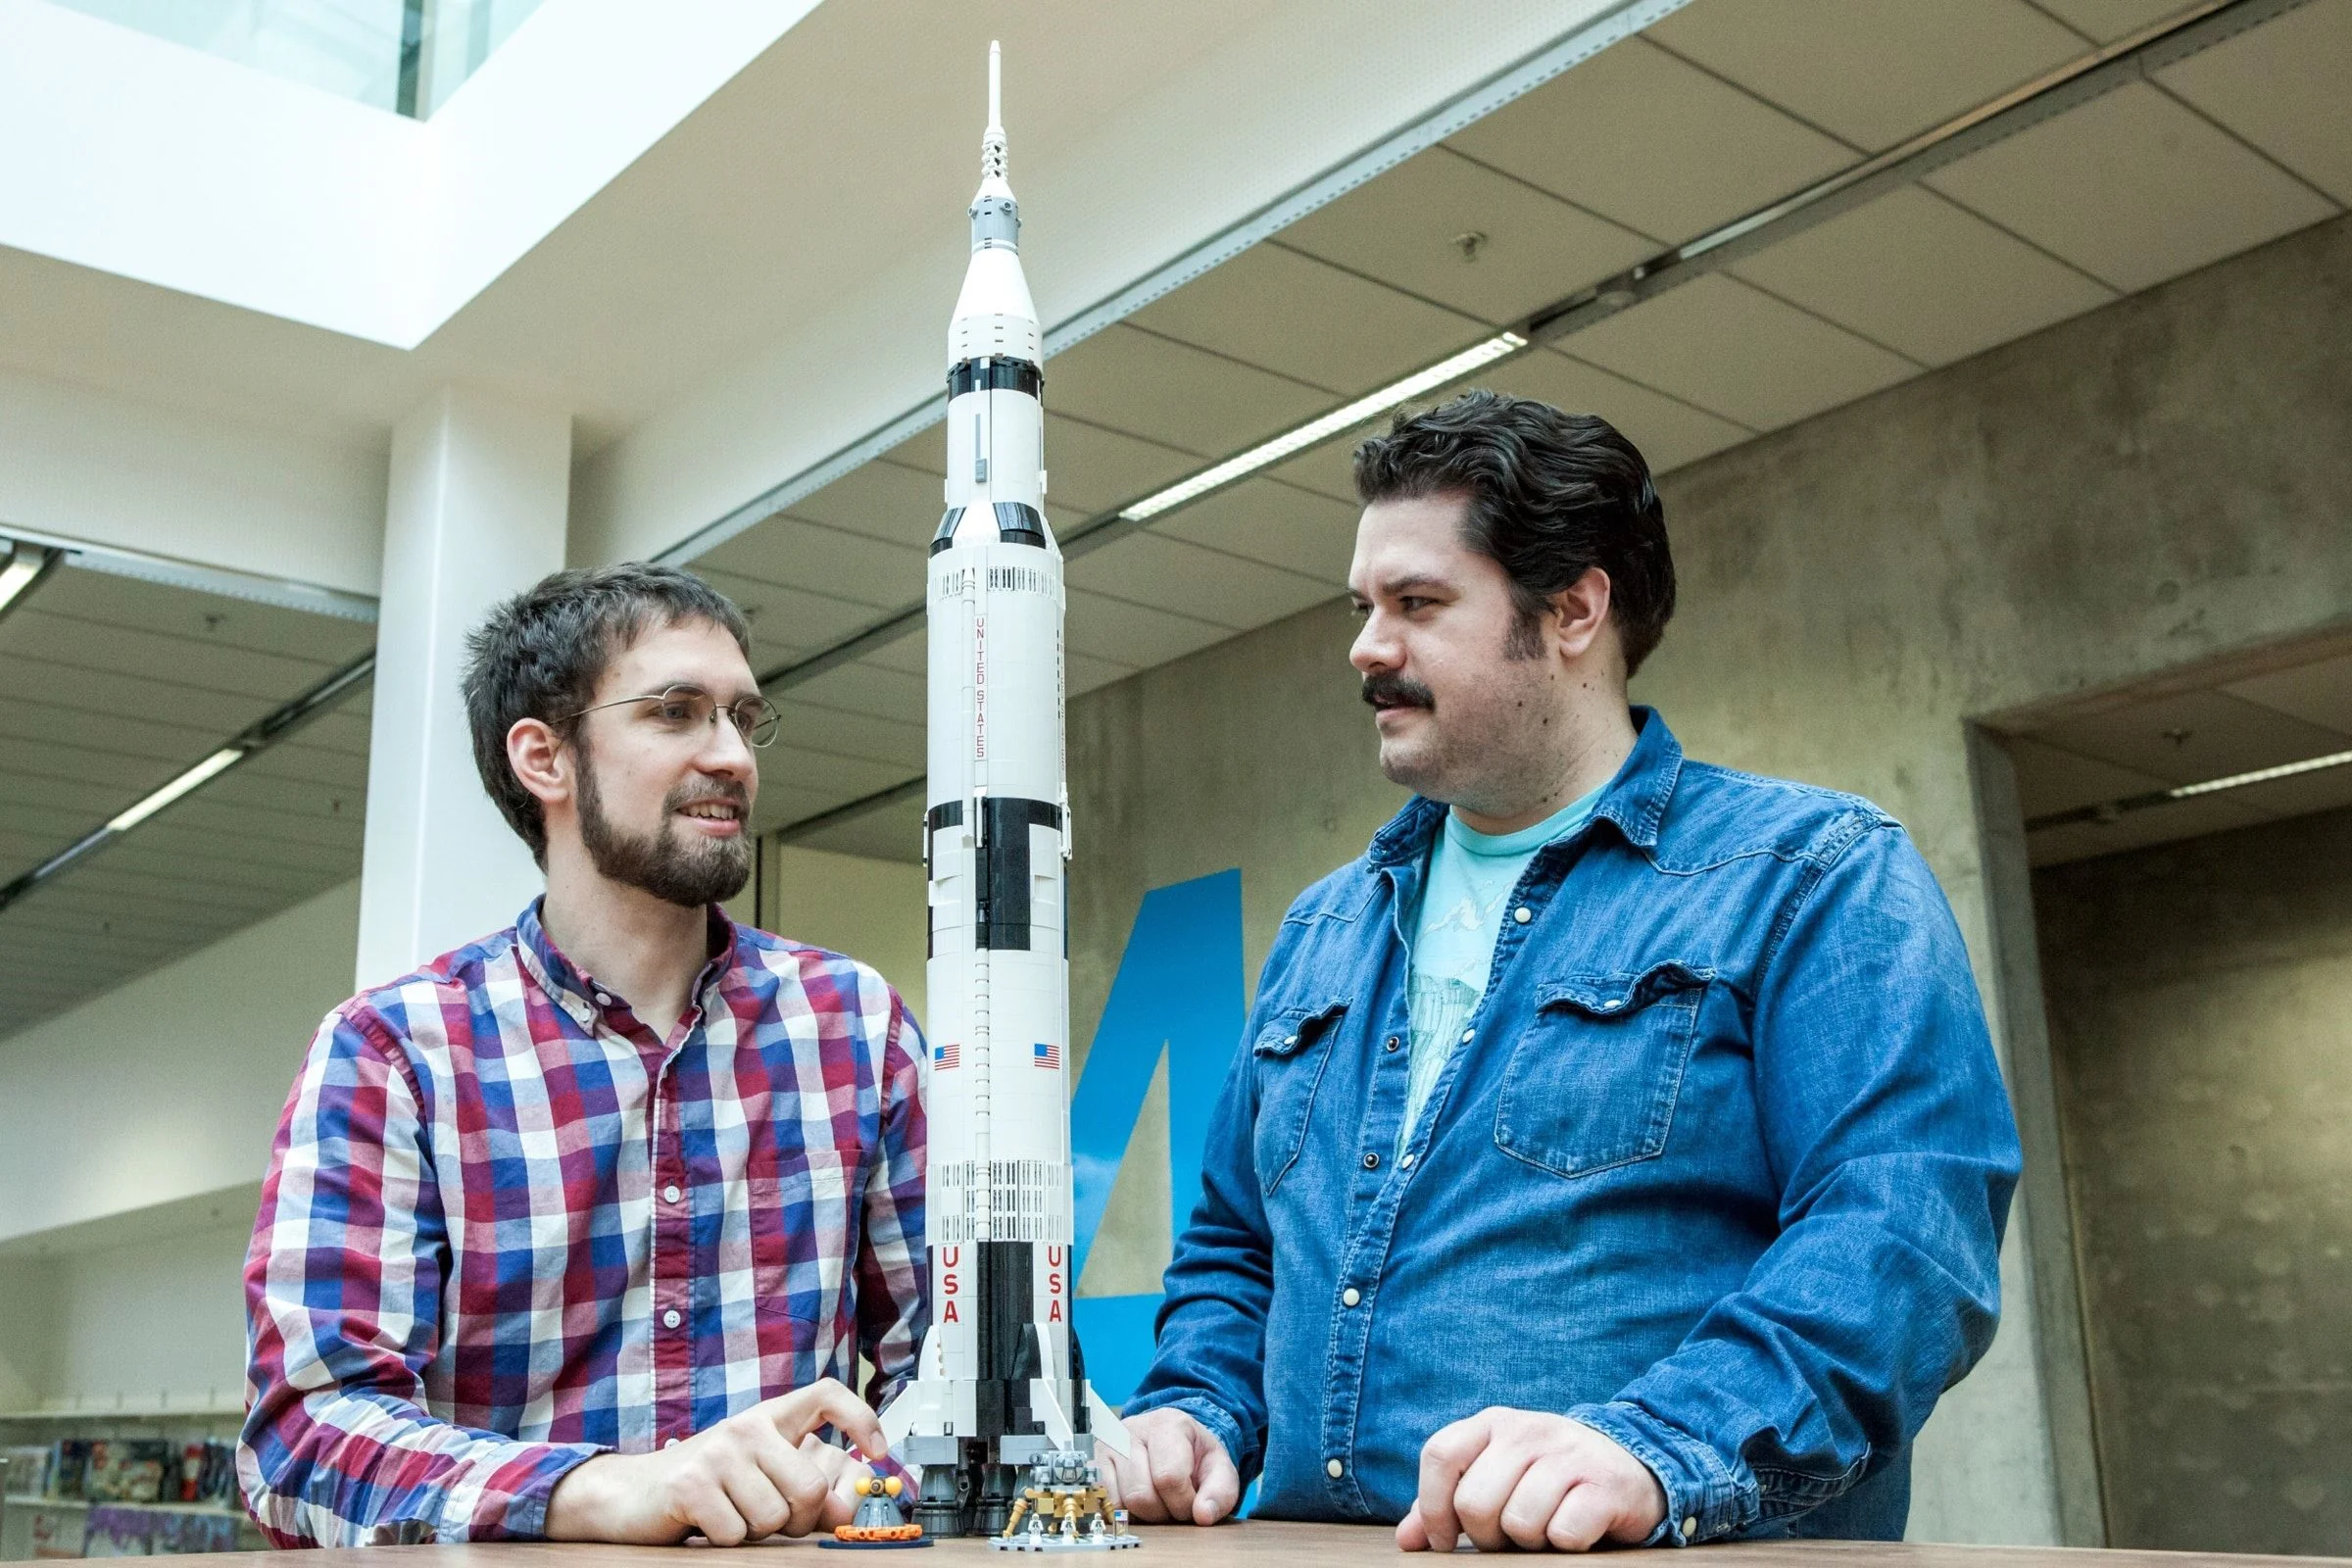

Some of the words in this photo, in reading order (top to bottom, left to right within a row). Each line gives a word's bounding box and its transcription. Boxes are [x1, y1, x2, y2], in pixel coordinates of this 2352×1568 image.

[976, 618, 985, 685] UNITED
[976, 690, 985, 758] STATES
[943, 1246, 958, 1323] USA
[1048, 1246, 1061, 1322] USA
